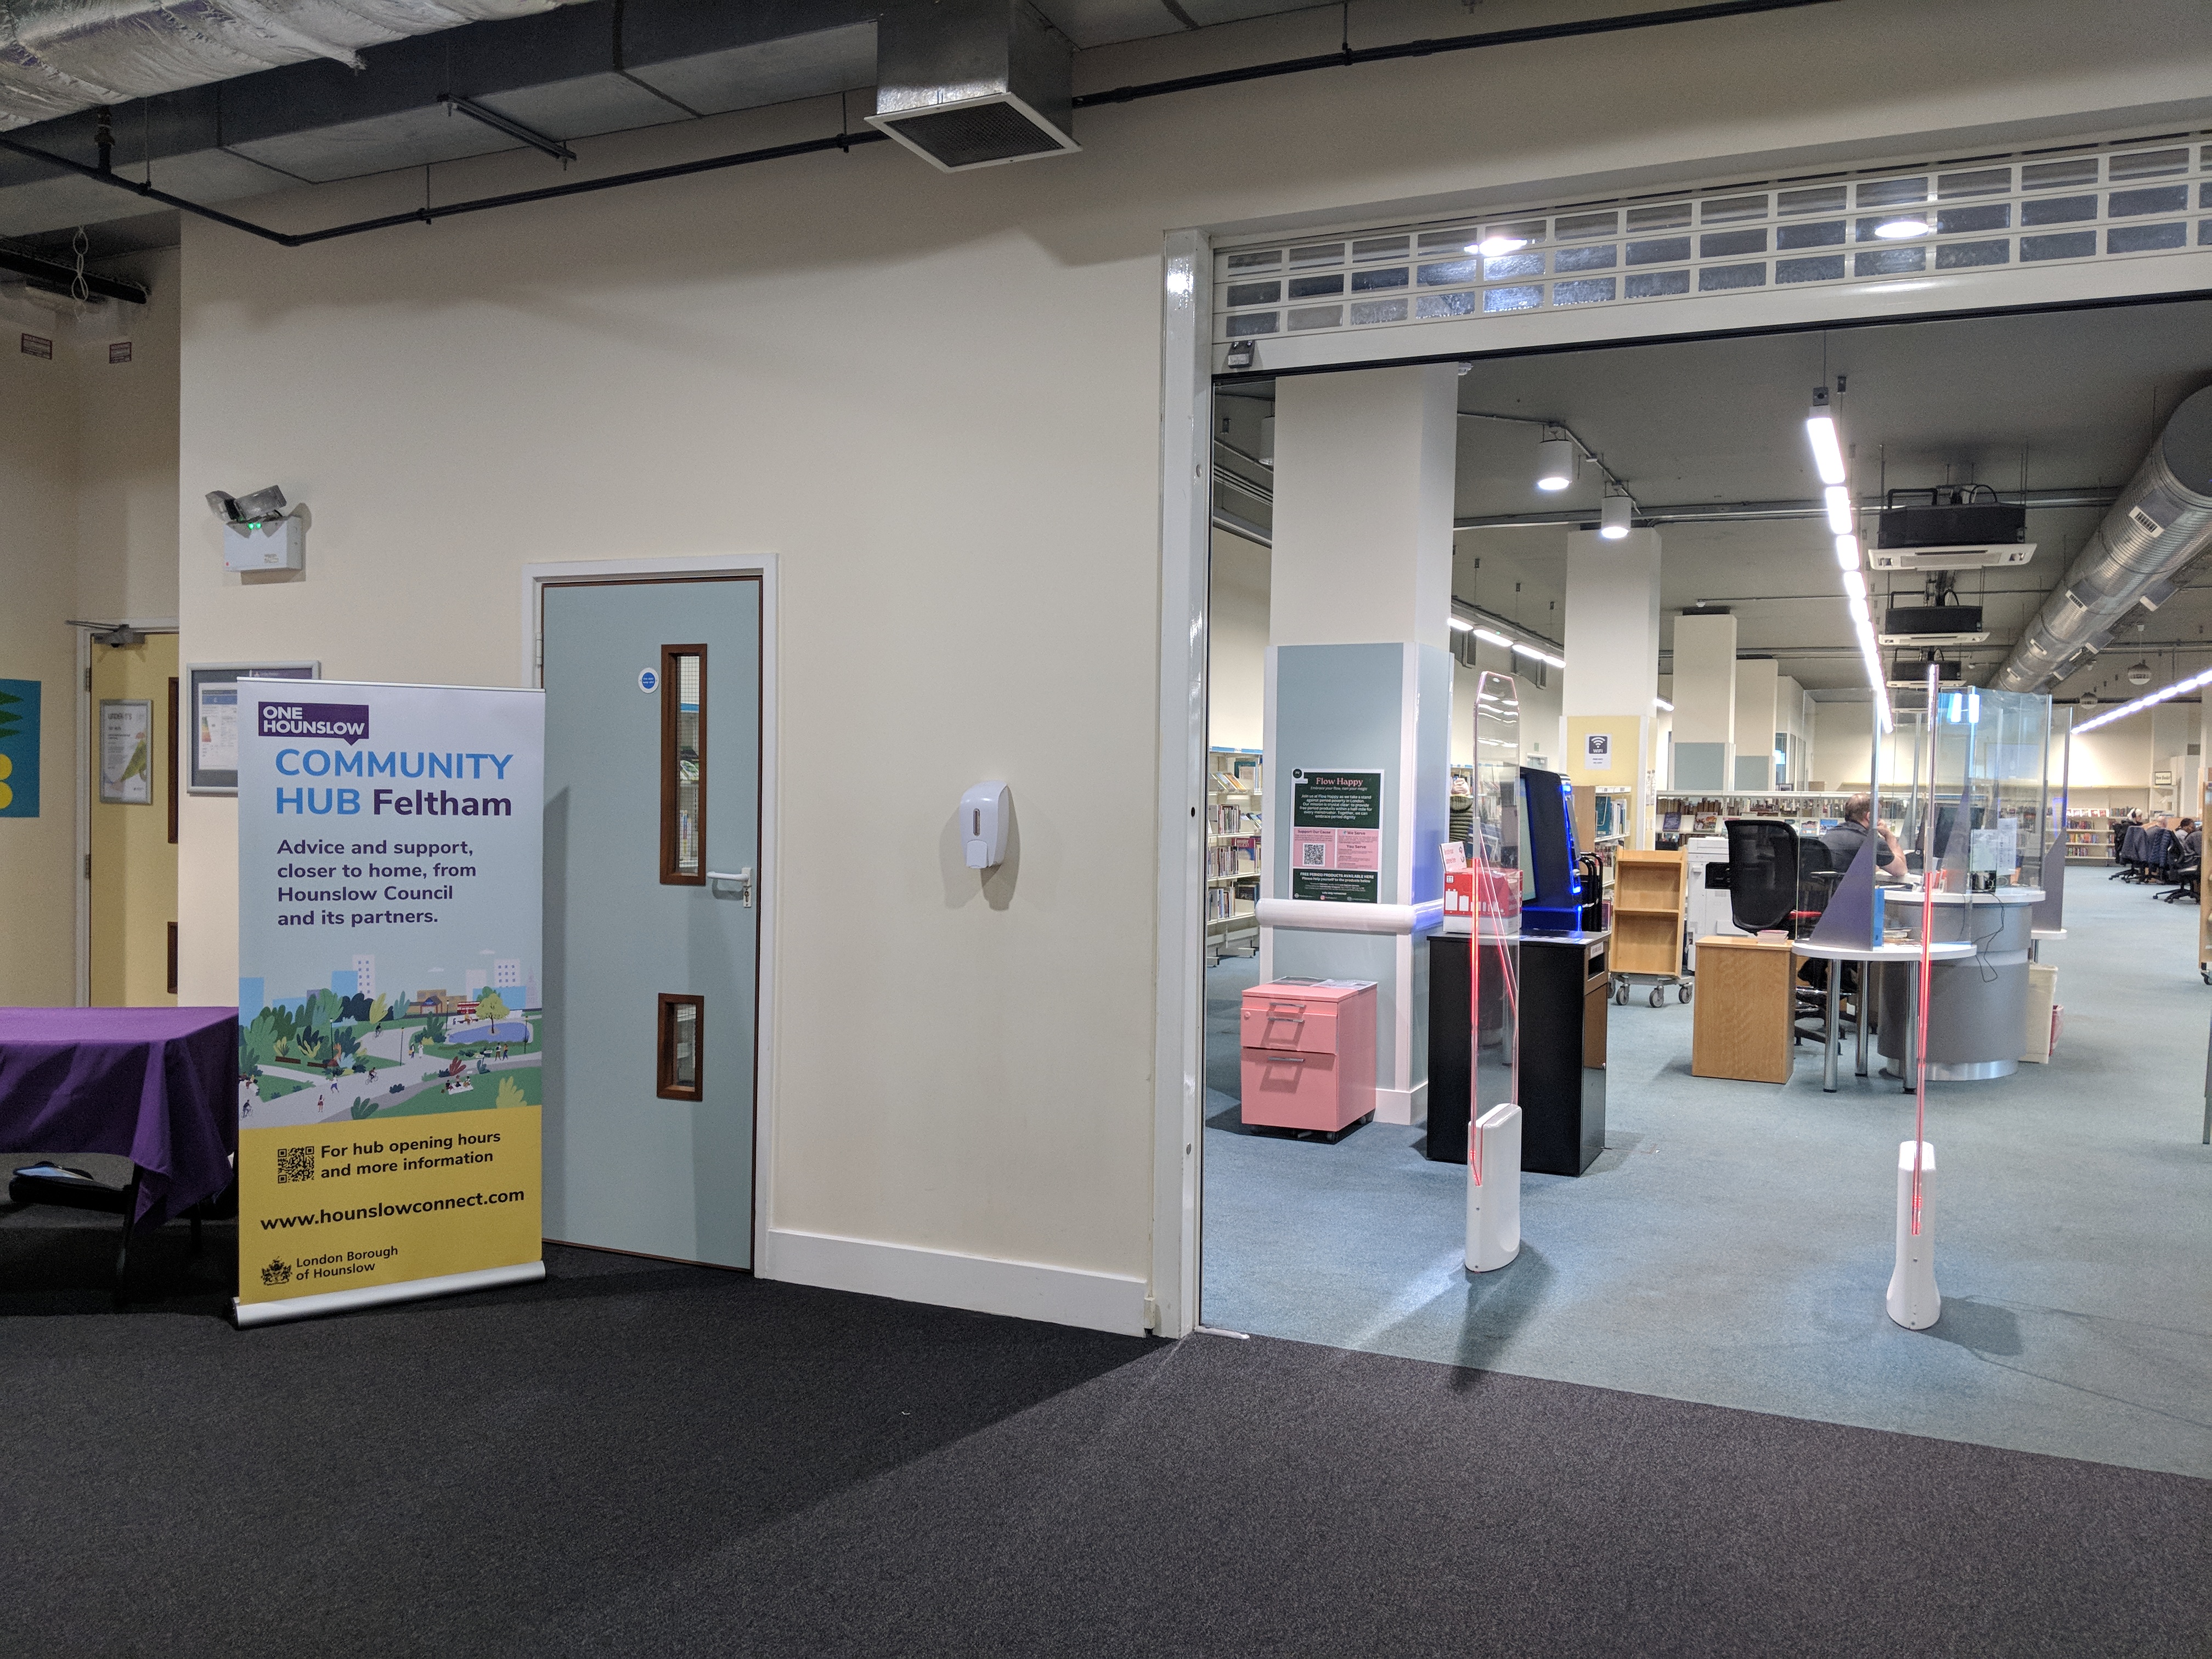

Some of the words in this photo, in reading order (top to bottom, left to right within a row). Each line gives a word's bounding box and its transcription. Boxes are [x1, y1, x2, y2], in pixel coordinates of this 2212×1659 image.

[263, 706, 303, 719] ONE
[263, 720, 365, 735] HOUNSLOW
[275, 748, 514, 780] COMMUNITY
[1316, 777, 1335, 785] Flow
[1337, 777, 1363, 787] Happy
[276, 787, 360, 815] HUB
[374, 789, 511, 816] Feltham
[276, 839, 345, 854] Advice
[351, 839, 387, 854] and
[393, 841, 473, 857] support,
[277, 863, 337, 878] closer
[342, 864, 362, 878] to
[369, 863, 427, 879] home,
[432, 862, 476, 877] from
[278, 886, 377, 902] Hounslow
[384, 884, 453, 900] Council
[278, 910, 314, 926] and
[321, 910, 345, 925] its
[351, 910, 438, 928] partners.
[321, 1145, 348, 1159] For
[353, 1141, 384, 1155] hub
[389, 1136, 453, 1155] opening
[458, 1132, 501, 1147] hours
[321, 1163, 351, 1178] and
[357, 1161, 398, 1175] more
[403, 1152, 493, 1171] information
[260, 1189, 524, 1231] www.hounslowconnect.com
[296, 1254, 342, 1268] London
[347, 1245, 398, 1262] Borough
[296, 1269, 309, 1281] of
[314, 1262, 375, 1278] Hounslow
